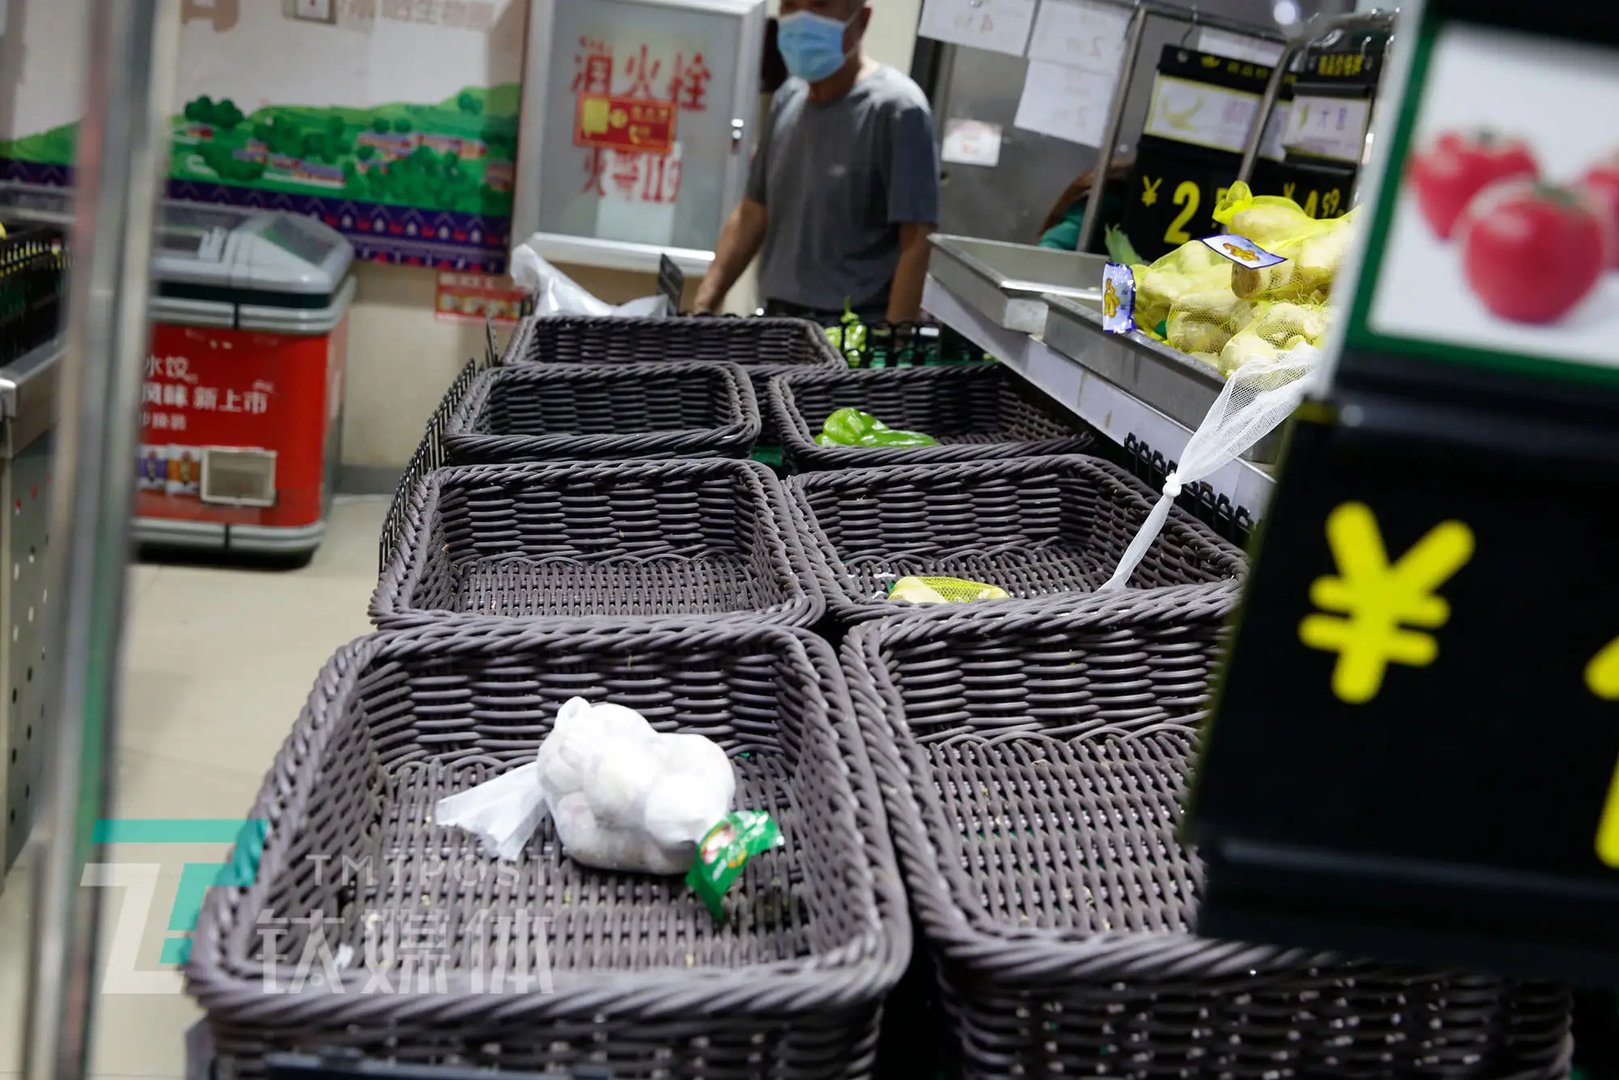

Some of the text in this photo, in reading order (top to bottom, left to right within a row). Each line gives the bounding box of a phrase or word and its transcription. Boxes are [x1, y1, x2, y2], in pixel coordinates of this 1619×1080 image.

[571, 36, 711, 110] 消火栓
[195, 388, 268, 414] 新上市
[1299, 501, 1476, 704] ¥
